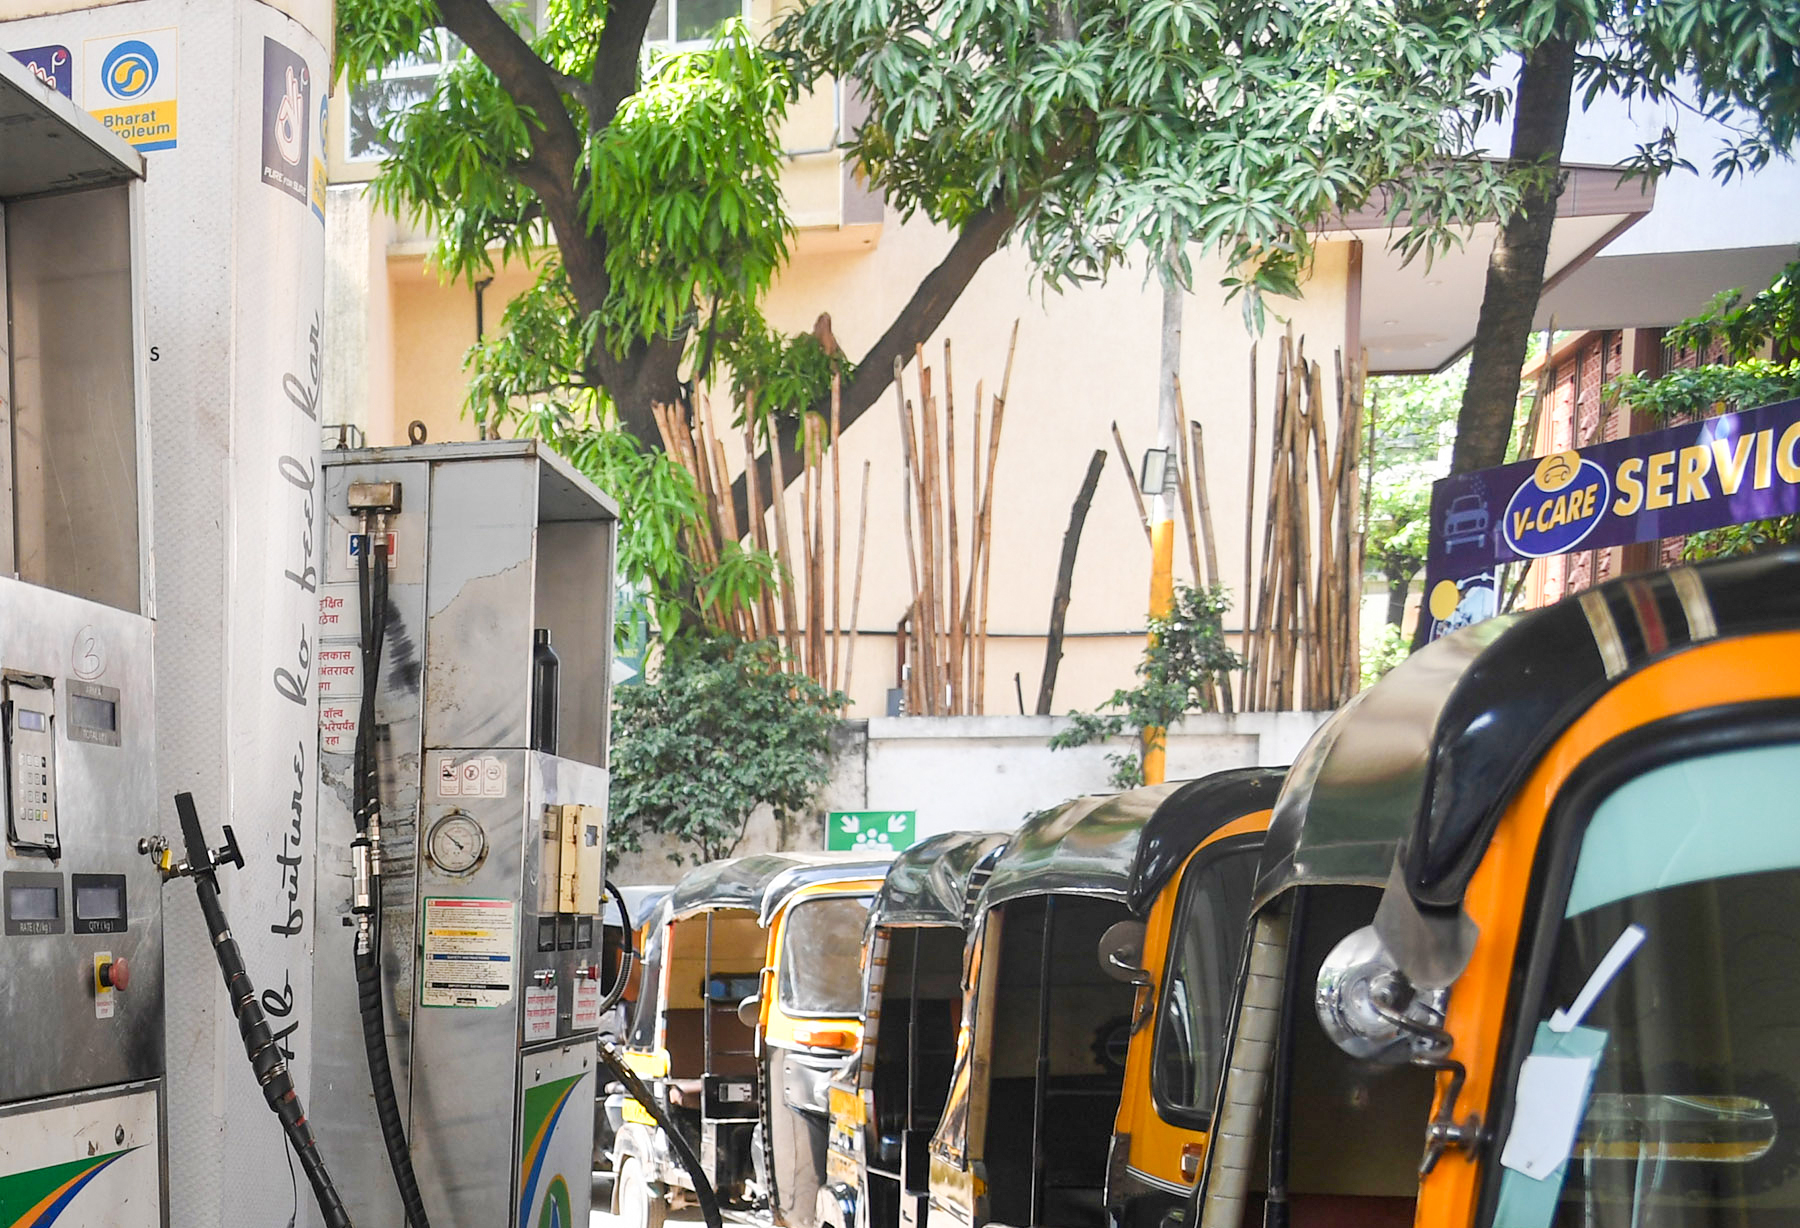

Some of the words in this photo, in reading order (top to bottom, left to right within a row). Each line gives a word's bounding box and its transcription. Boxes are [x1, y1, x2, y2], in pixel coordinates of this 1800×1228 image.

[104, 110, 156, 128] Bharat
[110, 123, 170, 139] roleum
[264, 165, 283, 183] PURE
[1513, 484, 1598, 541] V-CARE
